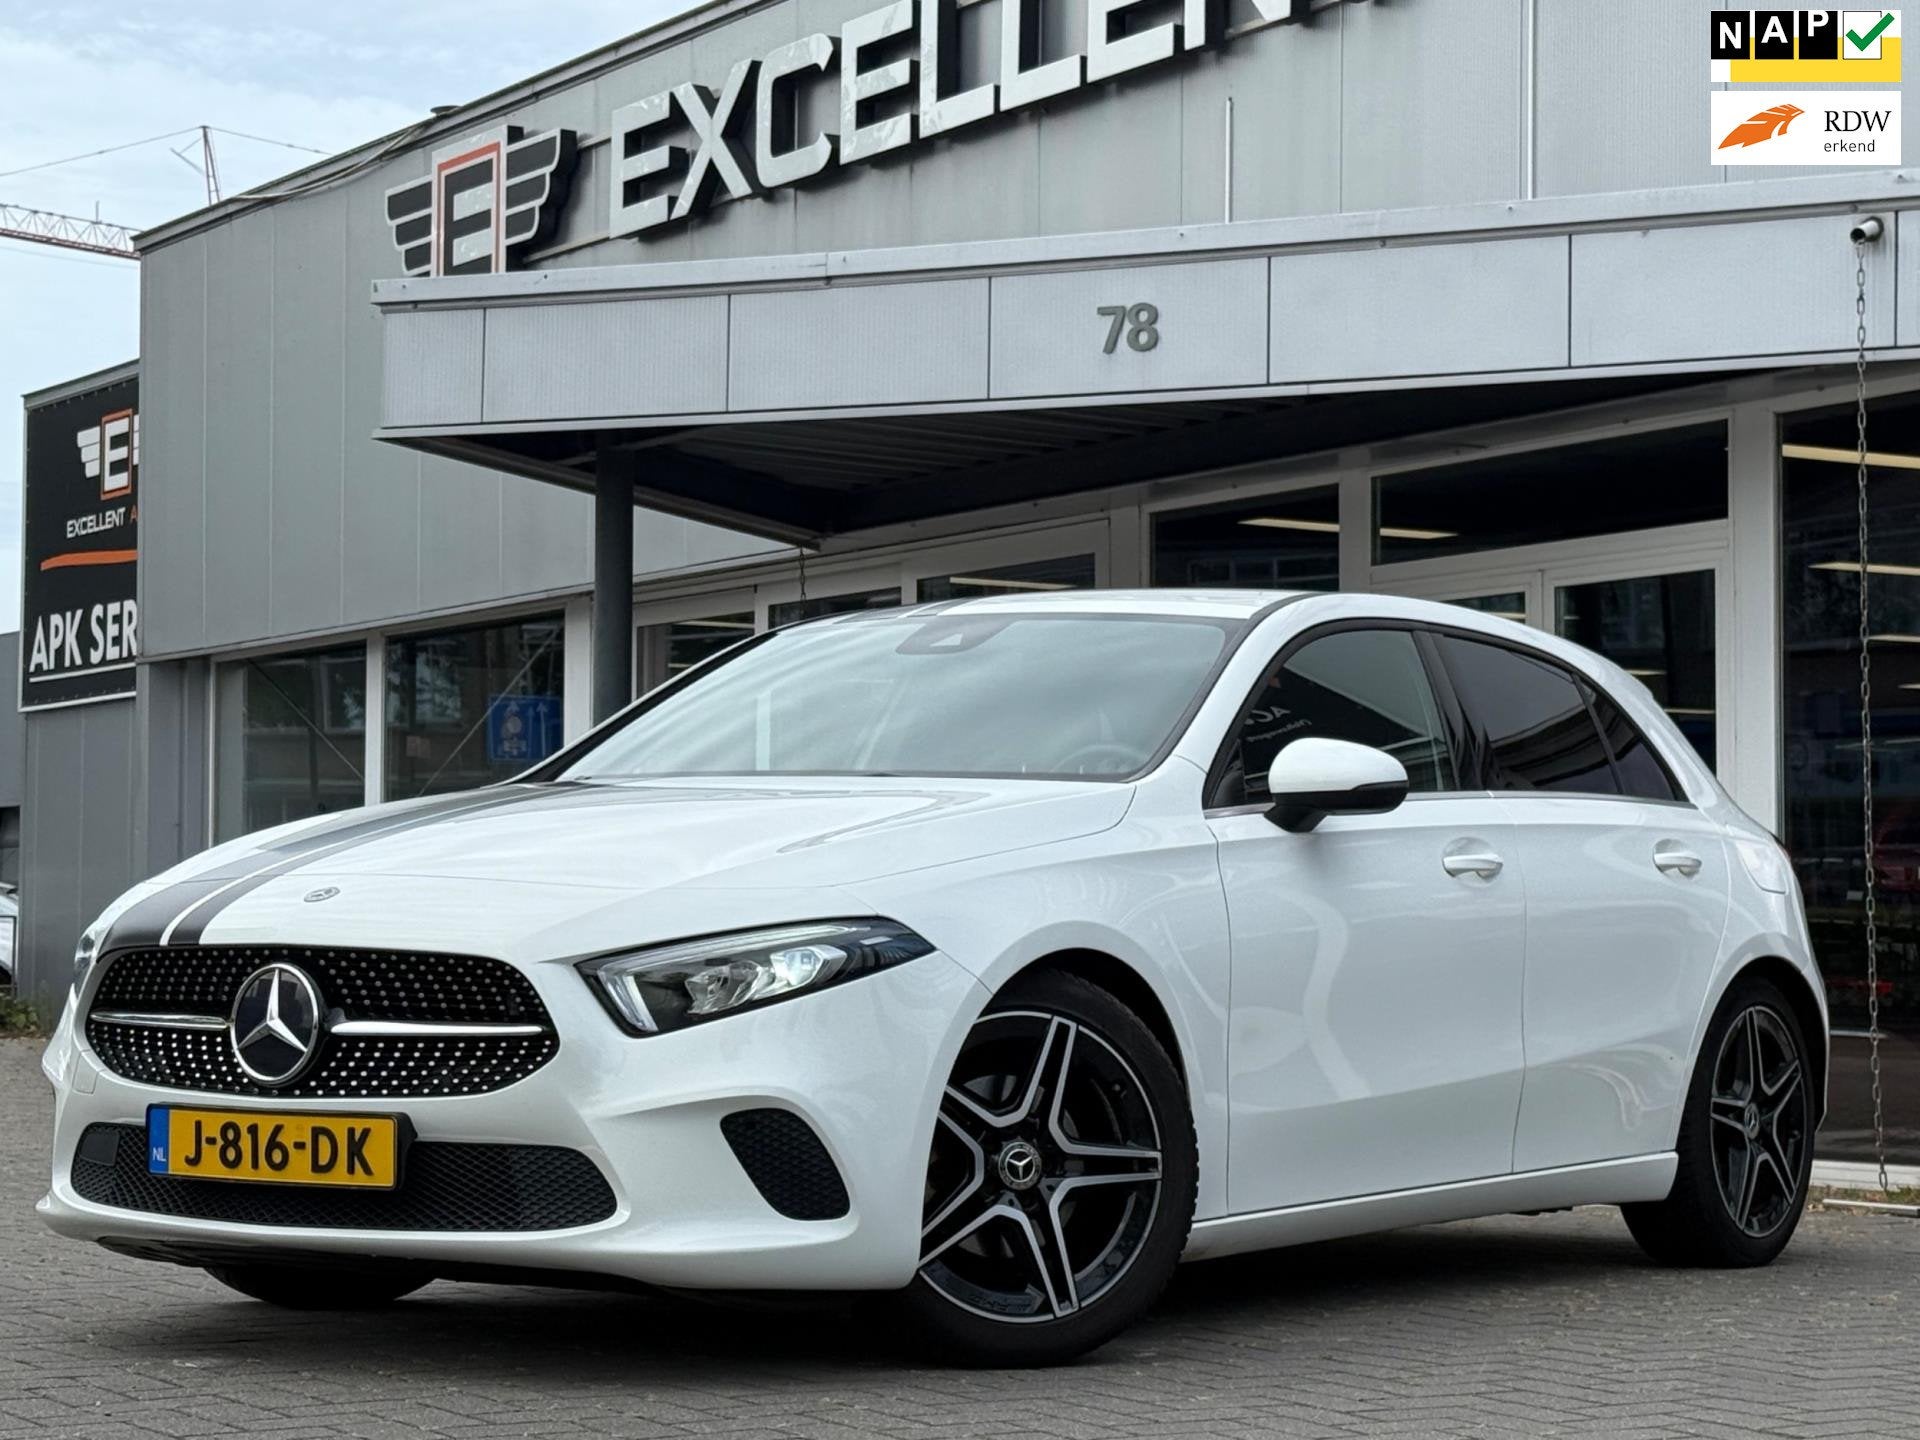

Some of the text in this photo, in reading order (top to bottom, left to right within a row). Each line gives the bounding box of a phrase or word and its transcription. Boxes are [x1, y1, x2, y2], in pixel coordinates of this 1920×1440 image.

[609, 0, 1292, 239] EXCELL
[1096, 302, 1159, 355] 78
[66, 506, 126, 539] EXCELLENT
[29, 599, 137, 673] APK SER
[152, 1119, 374, 1177] NL J-816-DK
